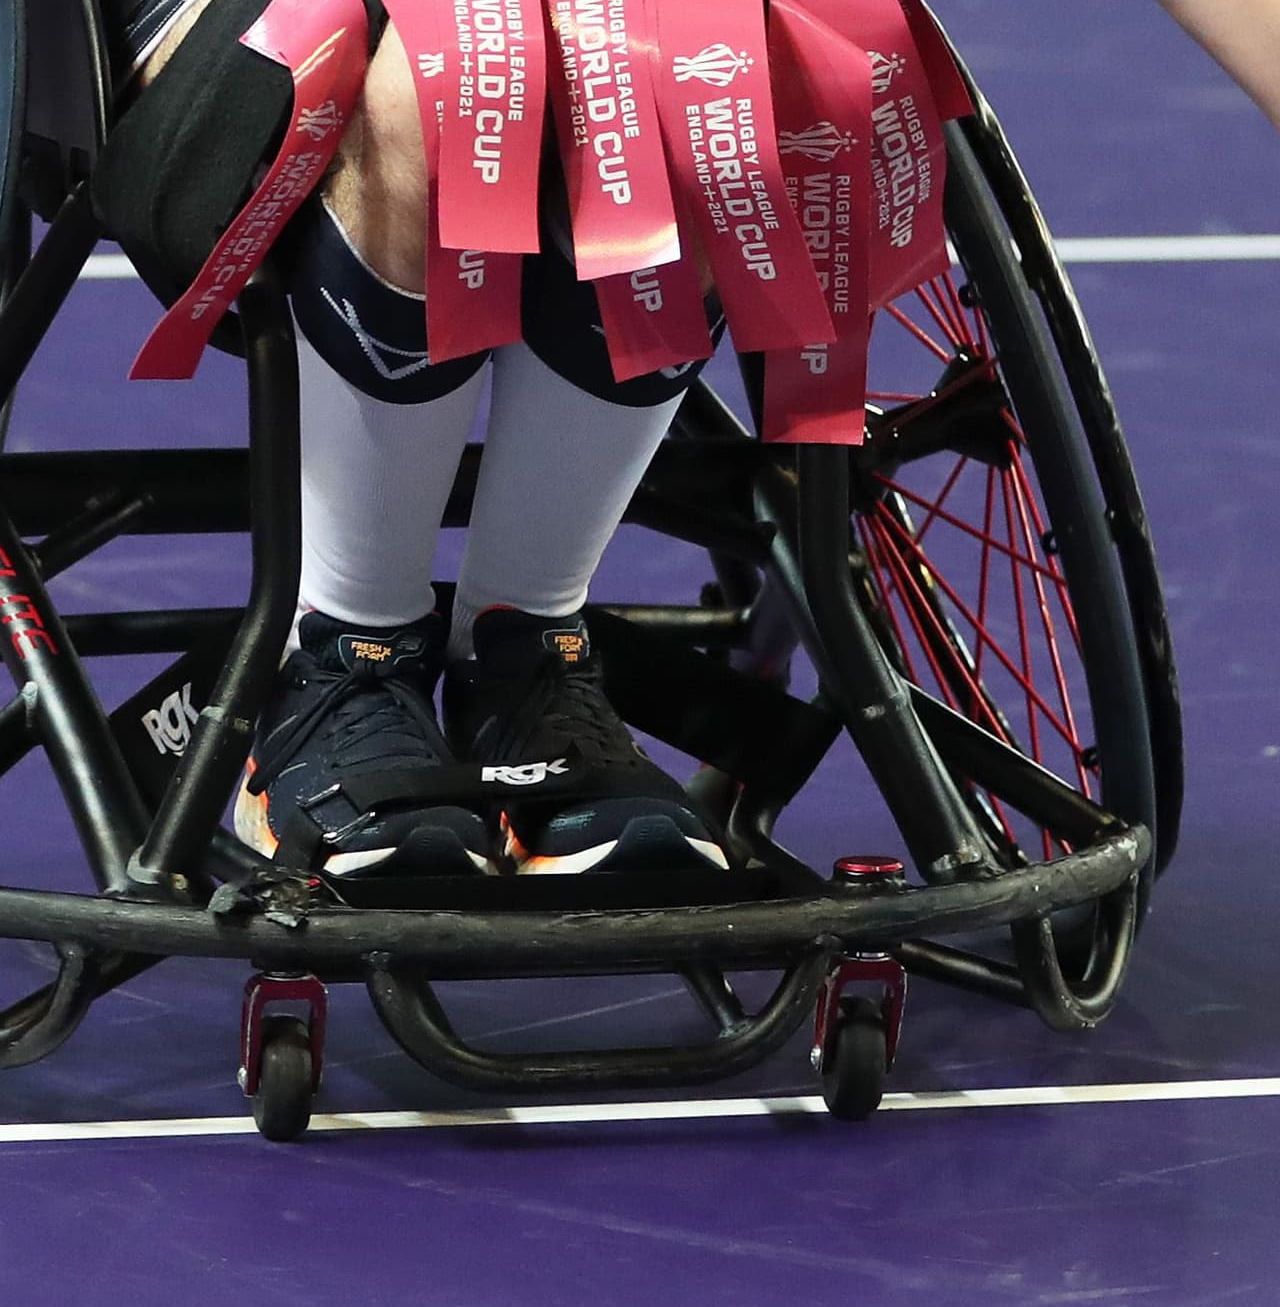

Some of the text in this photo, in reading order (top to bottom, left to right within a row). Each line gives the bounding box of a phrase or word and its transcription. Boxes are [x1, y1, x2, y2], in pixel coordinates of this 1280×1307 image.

[508, 46, 525, 121] LEAGUE
[614, 61, 640, 139] LEAGUE
[472, 110, 505, 184] CUP
[899, 95, 928, 151] RUGBY
[593, 131, 632, 205] CUP
[704, 97, 777, 281] WORLD CUP
[736, 98, 780, 230] RUGBY LEAGUE
[871, 100, 915, 248] WORLD CUP
[191, 152, 315, 320] WORLD CUP
[458, 250, 485, 289] UP
[834, 175, 851, 313] RUGBY LEAGUE
[630, 268, 663, 312] UP
[351, 641, 382, 652] FRESH
